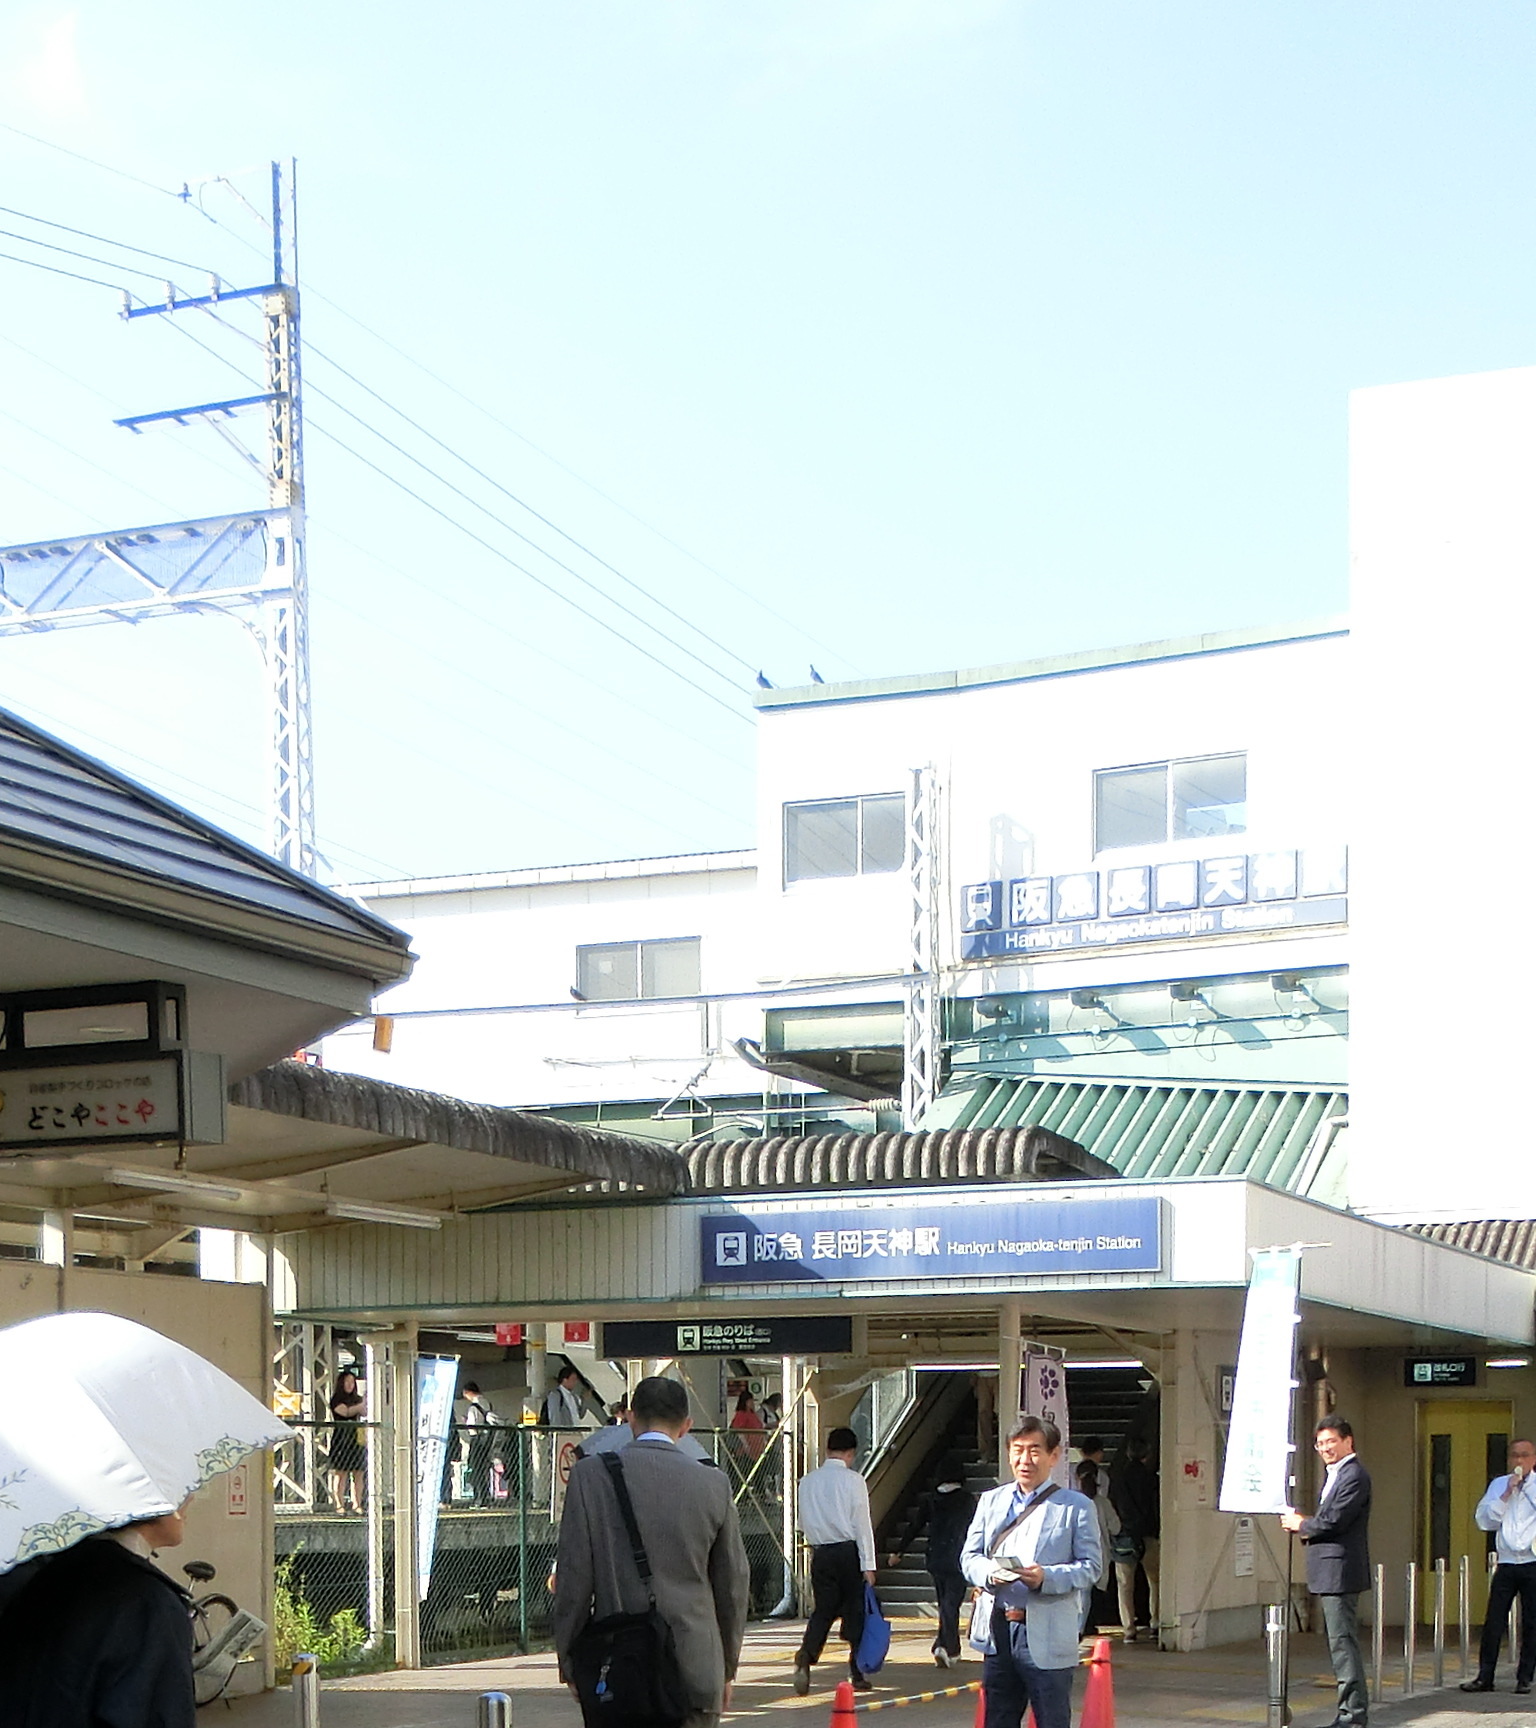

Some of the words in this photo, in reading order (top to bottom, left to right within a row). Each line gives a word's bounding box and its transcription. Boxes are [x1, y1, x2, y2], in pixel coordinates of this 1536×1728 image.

[1004, 926, 1074, 950] Hankyu
[28, 1099, 154, 1130] どこやここや
[754, 1232, 804, 1262] 阪急
[811, 1226, 941, 1260] 長岡天神駅
[947, 1240, 995, 1257] Hankyu
[997, 1236, 1093, 1255] Nagaoka-tenjin
[1096, 1234, 1142, 1250] Station
